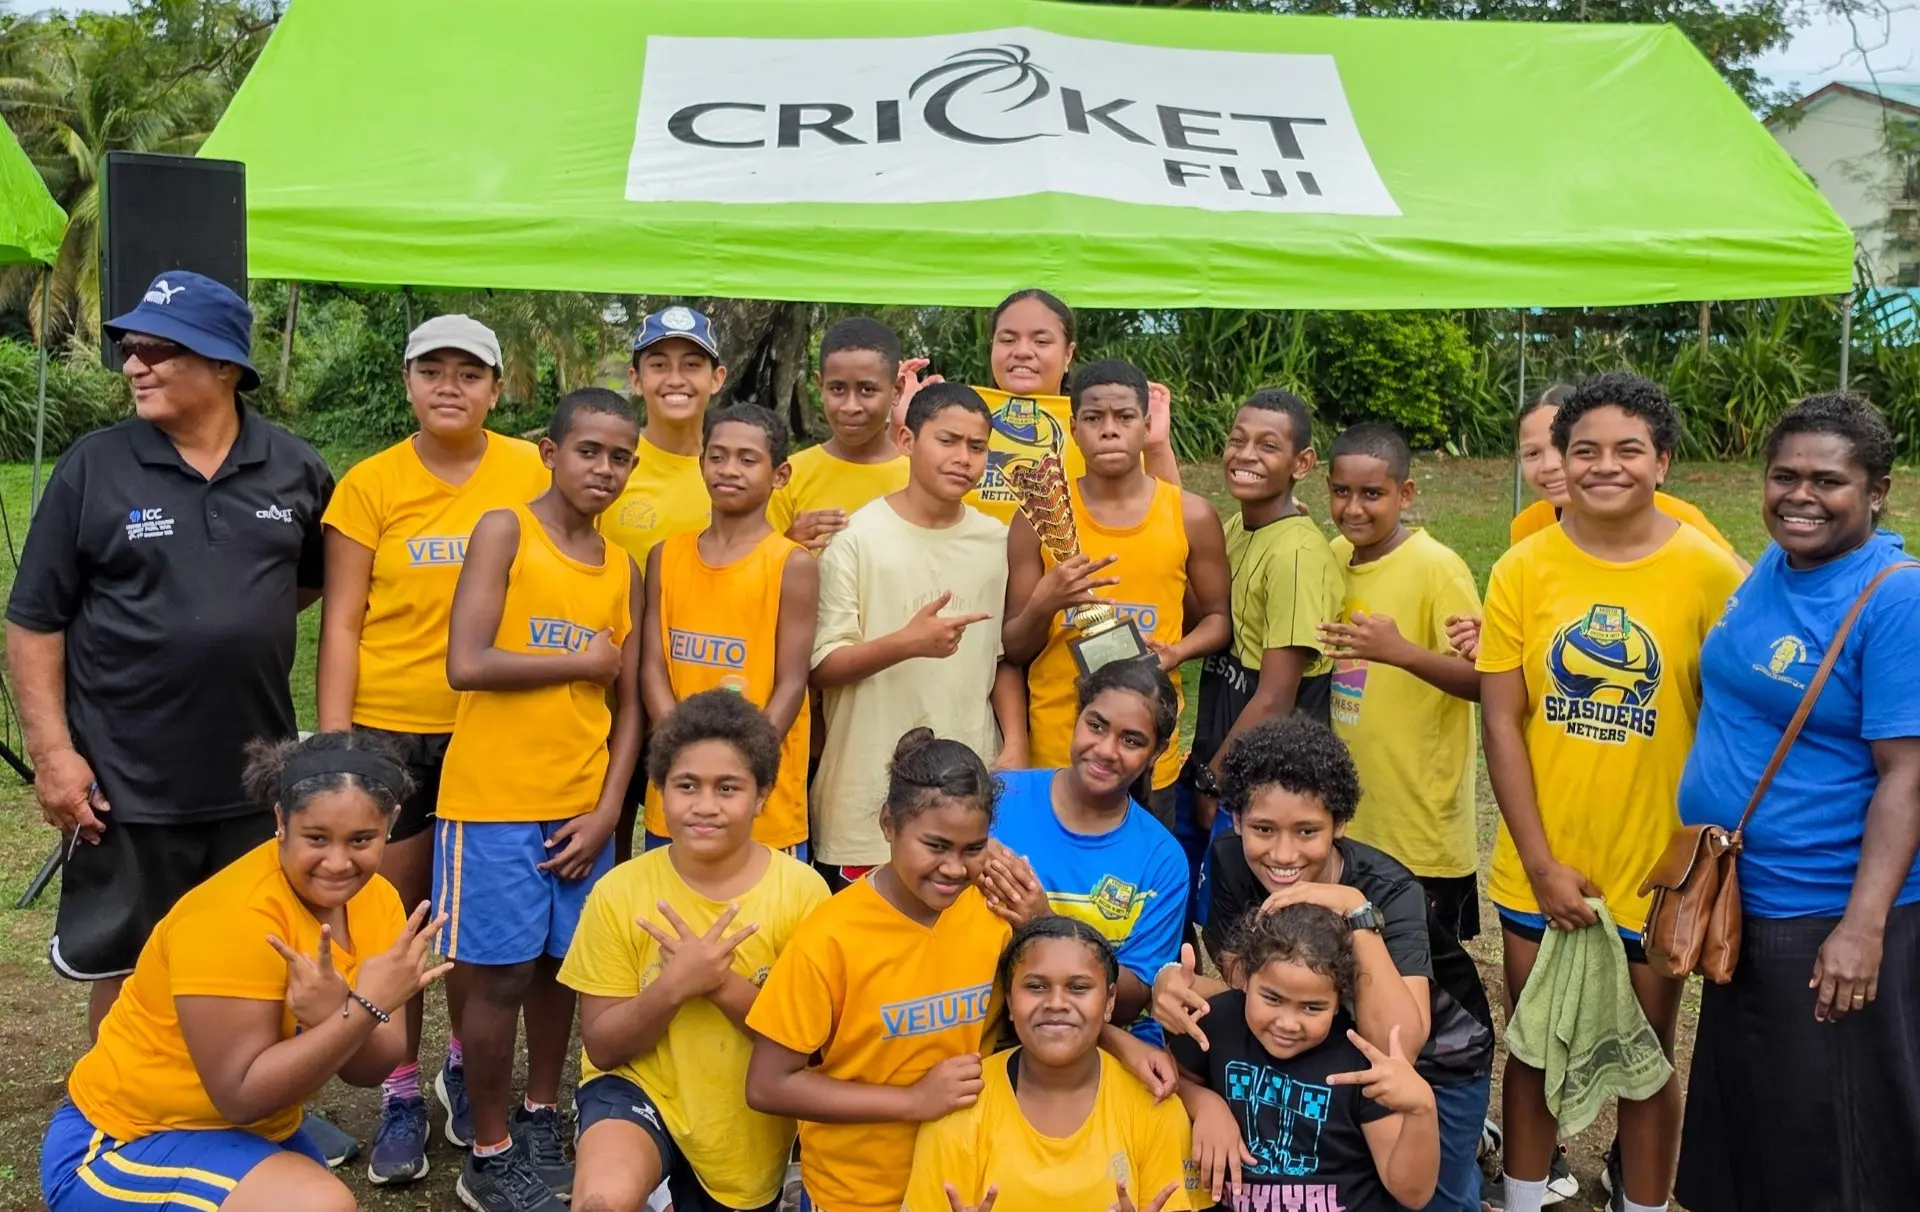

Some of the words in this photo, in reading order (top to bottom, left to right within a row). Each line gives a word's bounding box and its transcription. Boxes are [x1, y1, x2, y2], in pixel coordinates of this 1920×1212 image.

[667, 44, 1327, 161] CRICKET
[1162, 158, 1323, 199] FIJI
[981, 490, 1016, 501] NETTE
[142, 508, 163, 521] ICC
[671, 633, 746, 665] EIUTO
[1545, 695, 1657, 737] SEASIDERS
[1566, 722, 1627, 743] NETTERS
[1222, 1181, 1346, 1212] RVIVAL
